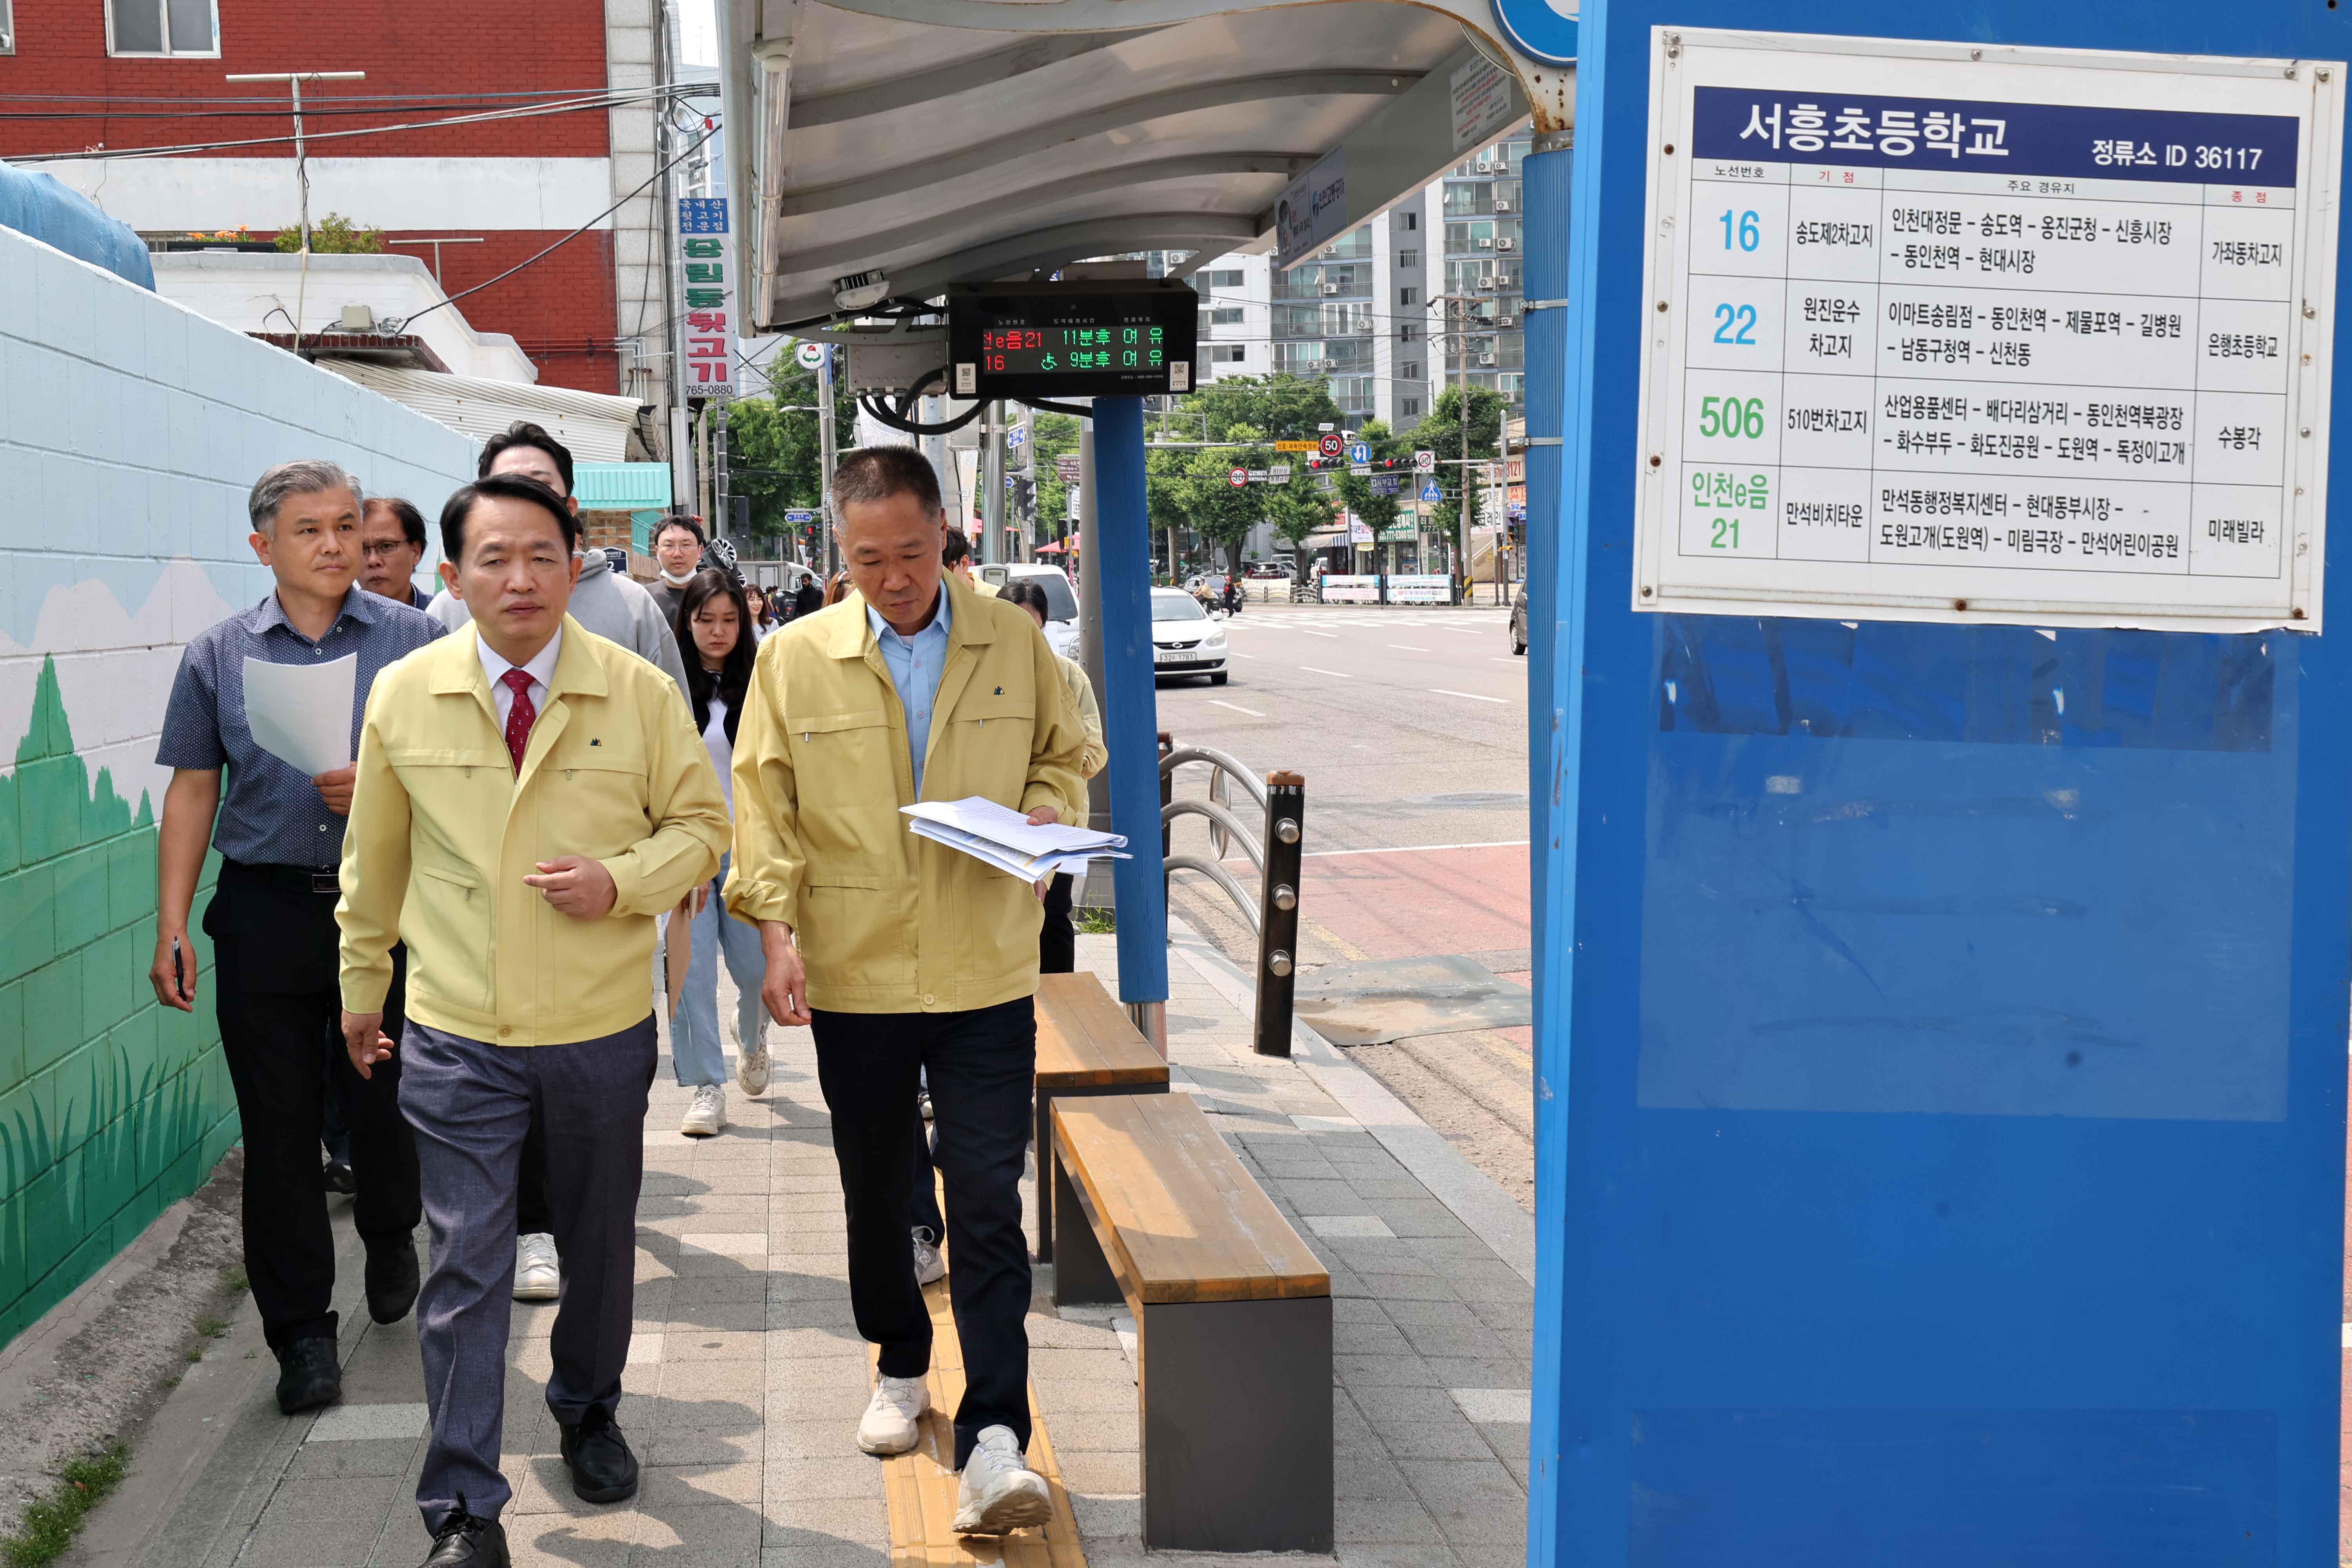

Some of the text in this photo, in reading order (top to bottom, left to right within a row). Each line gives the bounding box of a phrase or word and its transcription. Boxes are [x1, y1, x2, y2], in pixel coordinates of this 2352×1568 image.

[1740, 103, 2009, 158] 서흥초등학교
[2092, 140, 2262, 169] 정류소 ID 36117
[1715, 166, 1764, 178] 노선번호
[2008, 180, 2074, 194] 주요 경유지
[1720, 210, 1759, 251] 16
[1797, 221, 1872, 247] 송도제2차고지
[1893, 209, 1961, 234] 인천대정문
[1981, 213, 2021, 238] 송도역
[2042, 216, 2096, 241] 옹진군청
[2116, 220, 2171, 245] 신흥시장
[1905, 245, 1959, 270] 동인천역
[1980, 248, 2035, 273] 현대시장
[2213, 241, 2281, 266] 가좌동차고지
[1714, 303, 1756, 345] 22
[1804, 298, 1860, 323] 원진운수
[1889, 302, 1972, 328] 이마트송림점
[1991, 307, 2046, 332] 동인천역
[2066, 311, 2120, 335] 제물포역
[2141, 314, 2180, 338] 길병원
[1809, 334, 1851, 358] 차고지
[1902, 338, 1969, 364] 남동구청역
[1990, 342, 2031, 367] 신천동
[2209, 334, 2277, 358] 은행초등학교
[986, 355, 1005, 370] 16
[686, 385, 733, 395] 765-0880
[1700, 397, 1763, 439] 506
[1788, 409, 1866, 434] 510번차고지
[1885, 395, 1966, 421] 산업용품센터
[1987, 399, 2067, 425] 배다리삼거리
[2087, 404, 2183, 430] 동인천역북광장
[1325, 440, 1338, 450] 50
[1897, 430, 1952, 455] 화수부두
[1971, 434, 2038, 458] 화도진공원
[2058, 437, 2097, 461] 도원역
[2117, 440, 2184, 465] 독정이고개
[2219, 426, 2261, 450] 수봉각
[1232, 473, 1243, 481] 30
[1693, 473, 1769, 509] 인천e음
[1787, 503, 1862, 527] 만석비치타운
[1883, 489, 2006, 516] 만석동행정복지센터
[2027, 495, 2110, 521] 현대동부시장
[1711, 518, 1739, 548] 21
[1880, 524, 1987, 551] 도원고개(도원역)
[2008, 530, 2063, 554] 미림극장
[2082, 532, 2178, 558] 만석어린이공원
[2209, 519, 2264, 543] 미래빌라
